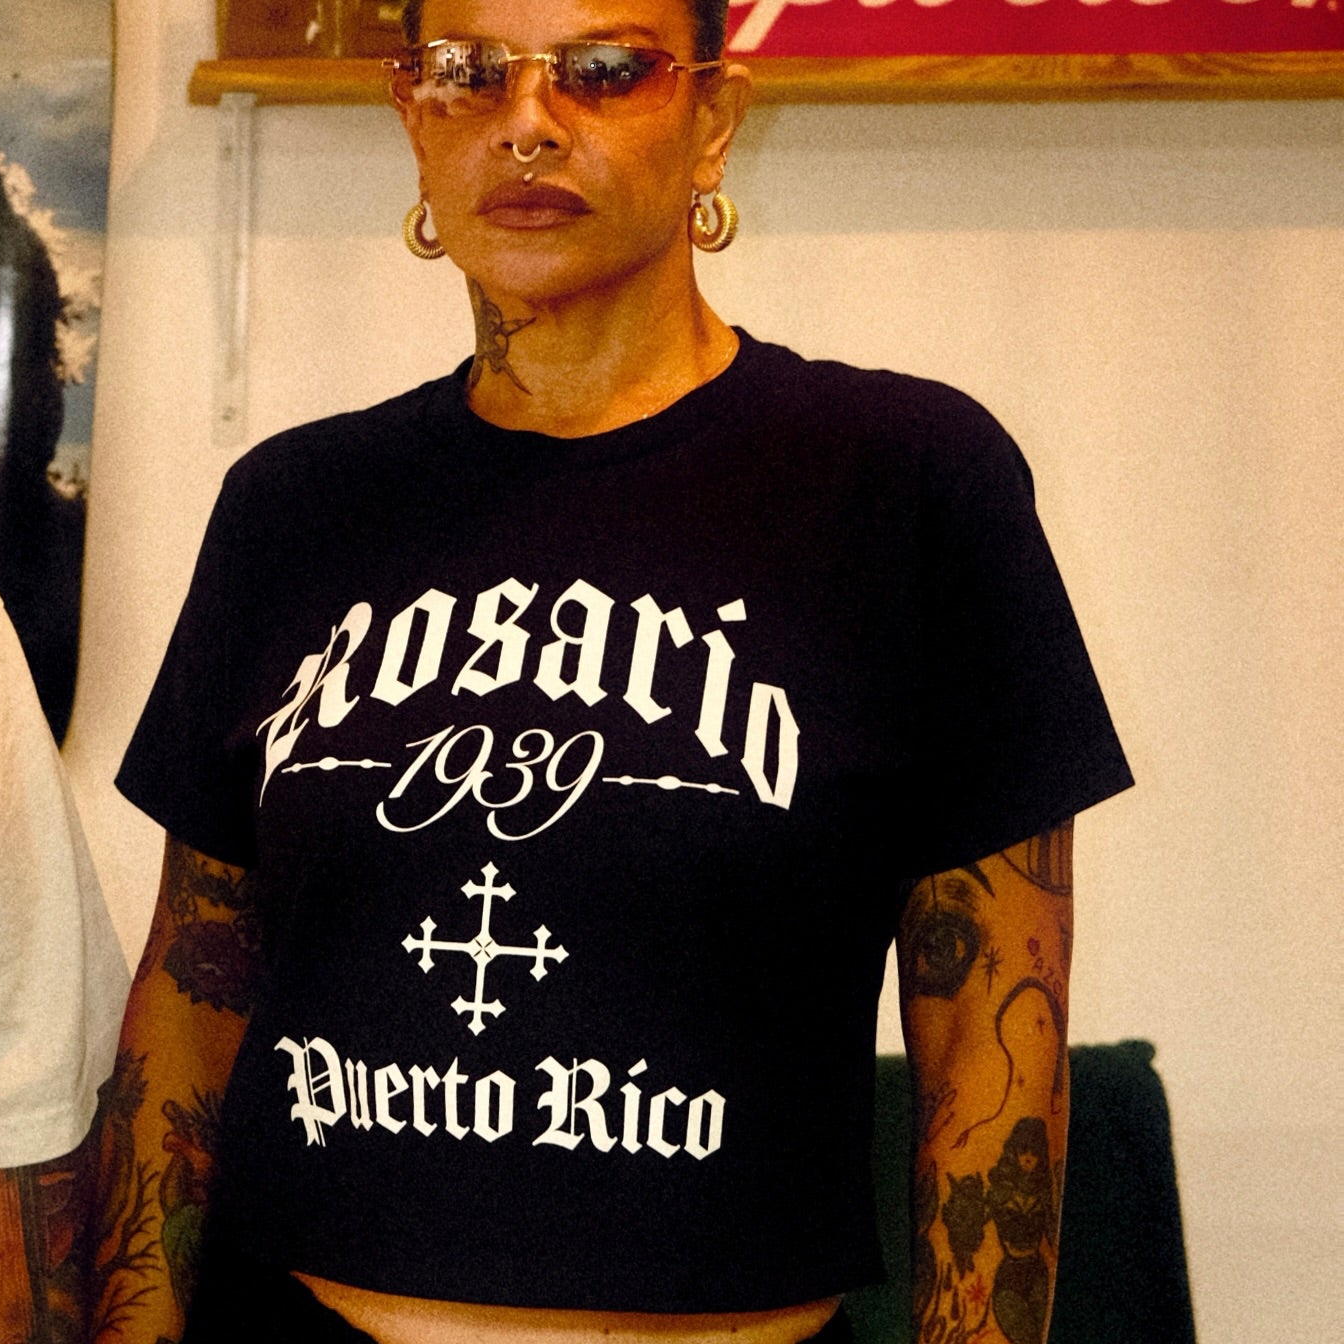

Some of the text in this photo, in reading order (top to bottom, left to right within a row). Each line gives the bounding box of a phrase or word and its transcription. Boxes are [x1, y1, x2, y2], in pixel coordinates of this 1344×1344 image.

[256, 577, 800, 810] Rosario
[376, 724, 604, 841] 1939
[274, 1036, 726, 1161] Puerto Rico
